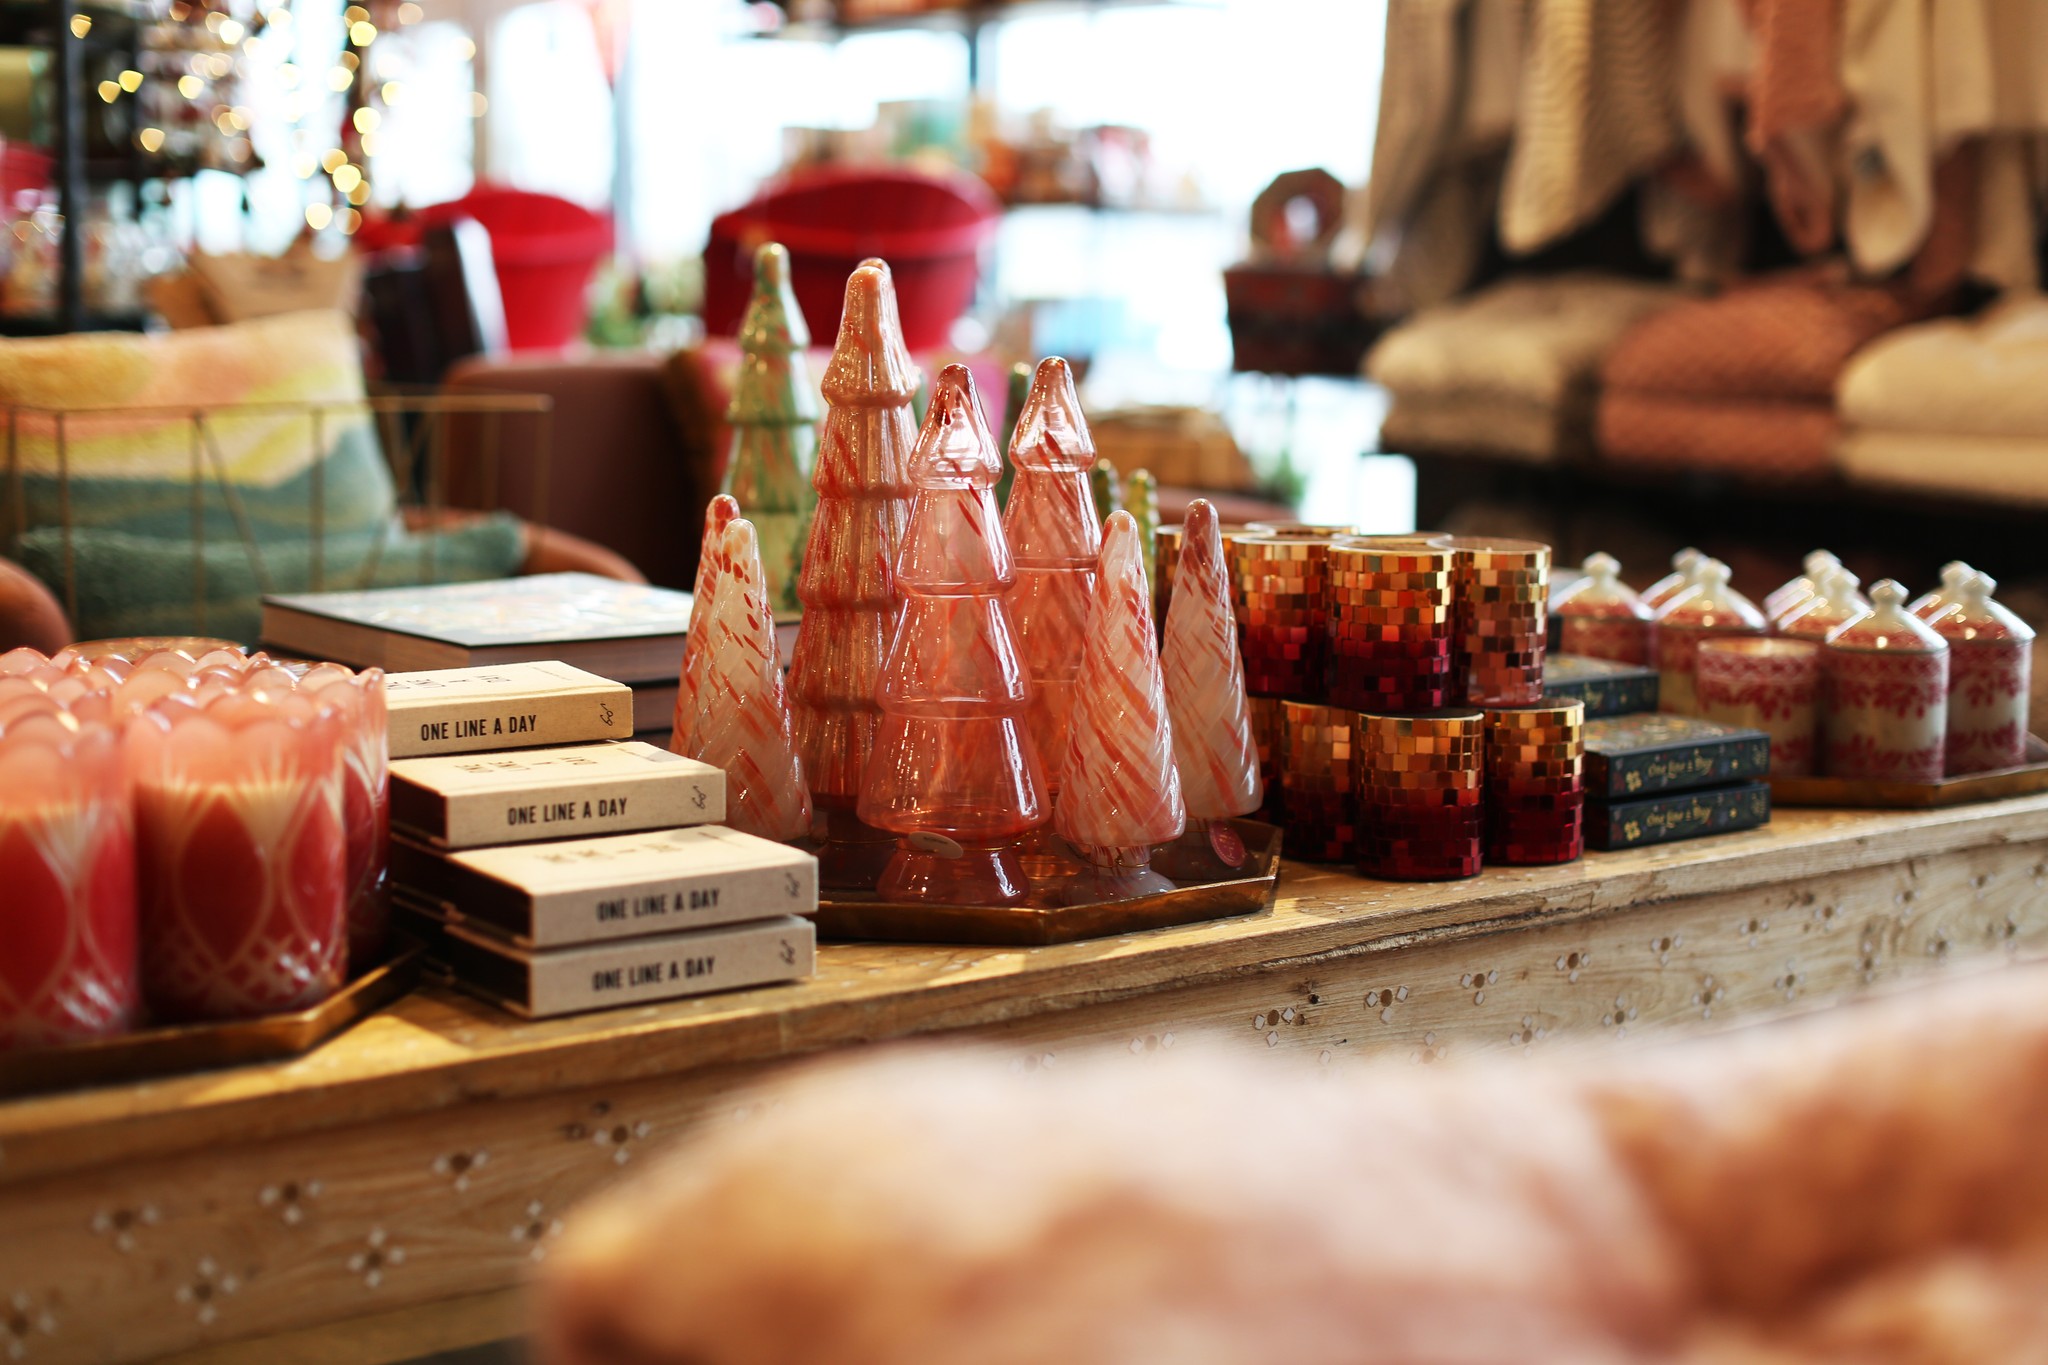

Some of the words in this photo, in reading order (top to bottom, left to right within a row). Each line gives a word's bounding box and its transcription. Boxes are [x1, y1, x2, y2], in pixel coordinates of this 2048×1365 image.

[421, 722, 449, 742] ONE
[456, 718, 487, 739] LINE
[493, 717, 503, 735] A
[509, 714, 537, 734] DAY
[507, 805, 537, 826] ONE
[543, 802, 576, 823] LINE
[582, 800, 592, 819] A
[598, 797, 628, 817] DAY
[596, 900, 628, 923] ONE
[633, 894, 668, 918] LINE
[672, 890, 684, 912] A
[689, 887, 721, 910] DAY
[591, 968, 623, 992] ONE
[628, 962, 663, 988] LINE
[668, 960, 679, 981] A
[684, 955, 716, 979] DAY
